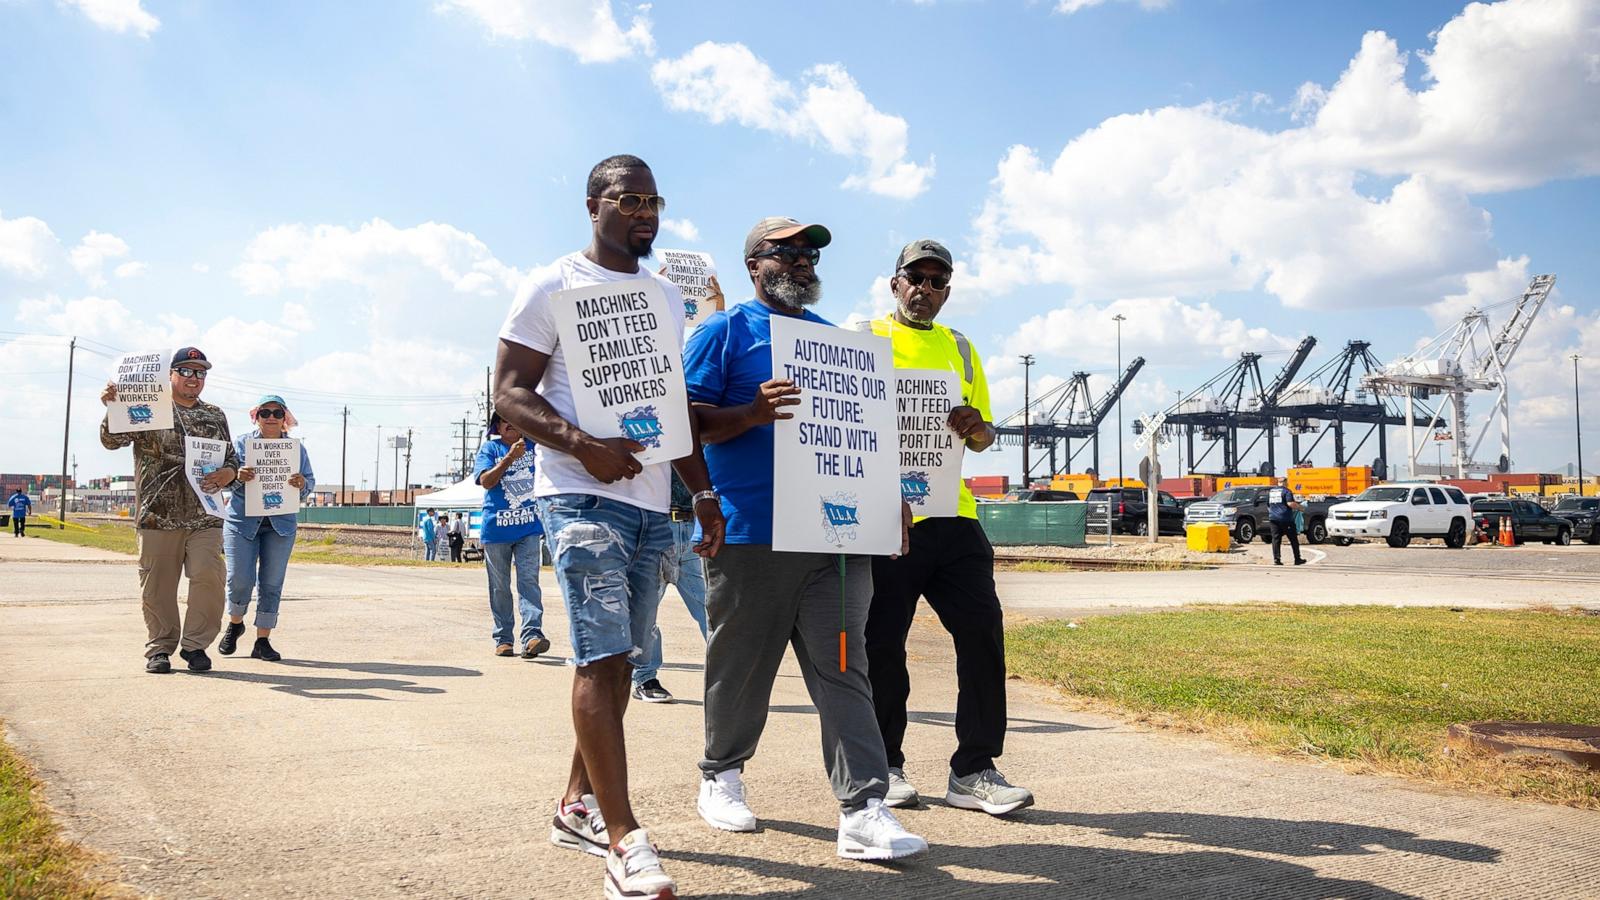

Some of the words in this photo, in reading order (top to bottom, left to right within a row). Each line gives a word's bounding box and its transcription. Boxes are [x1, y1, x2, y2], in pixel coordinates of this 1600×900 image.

[672, 264, 706, 276] FAMILIES:
[667, 273, 699, 286] SUPPORT
[576, 292, 648, 320] MACHINES
[577, 318, 620, 342] DON'T
[624, 312, 658, 334] FEED
[588, 336, 658, 363] FAMILIES:
[794, 338, 875, 372] AUTOMATION
[123, 354, 160, 364] MACHINES
[118, 364, 140, 374] DON'T
[142, 363, 160, 372] FEED
[582, 358, 648, 388] SUPPORT
[650, 355, 672, 375] ILA
[119, 374, 156, 383] FAMILIES:
[784, 364, 858, 396] THREATENS
[862, 377, 886, 400] OUR
[117, 384, 148, 392] UPPORT
[151, 384, 163, 392] ILA
[598, 378, 666, 408] WORKERS
[896, 379, 947, 395] ACHINES
[119, 394, 158, 402] WORKERS
[896, 398, 918, 413] N'T
[922, 398, 951, 413] FEED
[812, 396, 864, 424] FUTURE:
[800, 422, 842, 448] STAND
[846, 428, 877, 452] WITH
[934, 434, 952, 449] ILA
[815, 452, 840, 476] THE
[844, 456, 864, 478] ILA
[900, 452, 942, 467] ORKERS
[496, 508, 532, 519] LOCAL
[496, 514, 534, 527] HOUSTON
